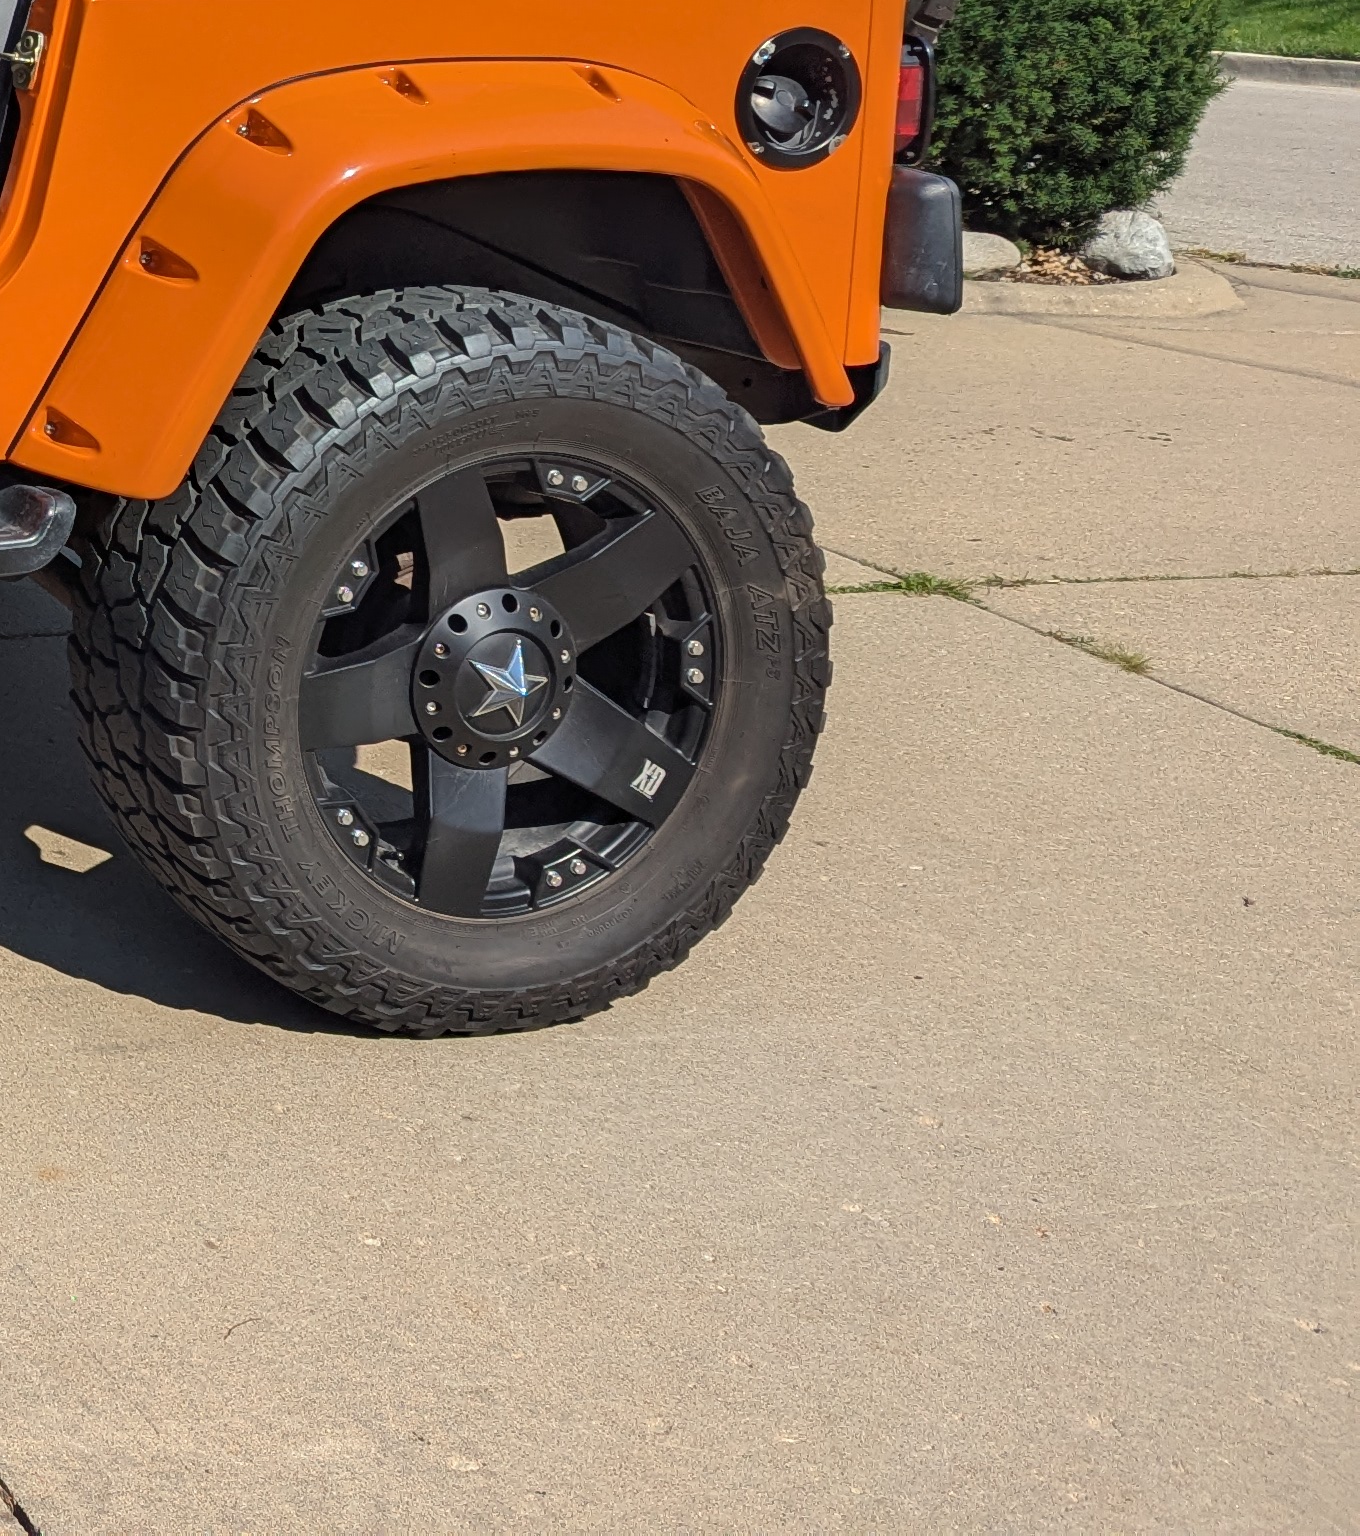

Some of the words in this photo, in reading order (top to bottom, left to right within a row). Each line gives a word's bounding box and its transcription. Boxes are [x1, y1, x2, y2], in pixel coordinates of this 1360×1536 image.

[694, 484, 761, 569] BAJA
[262, 634, 303, 843] THOMPSON
[296, 859, 407, 956] MICKEY
